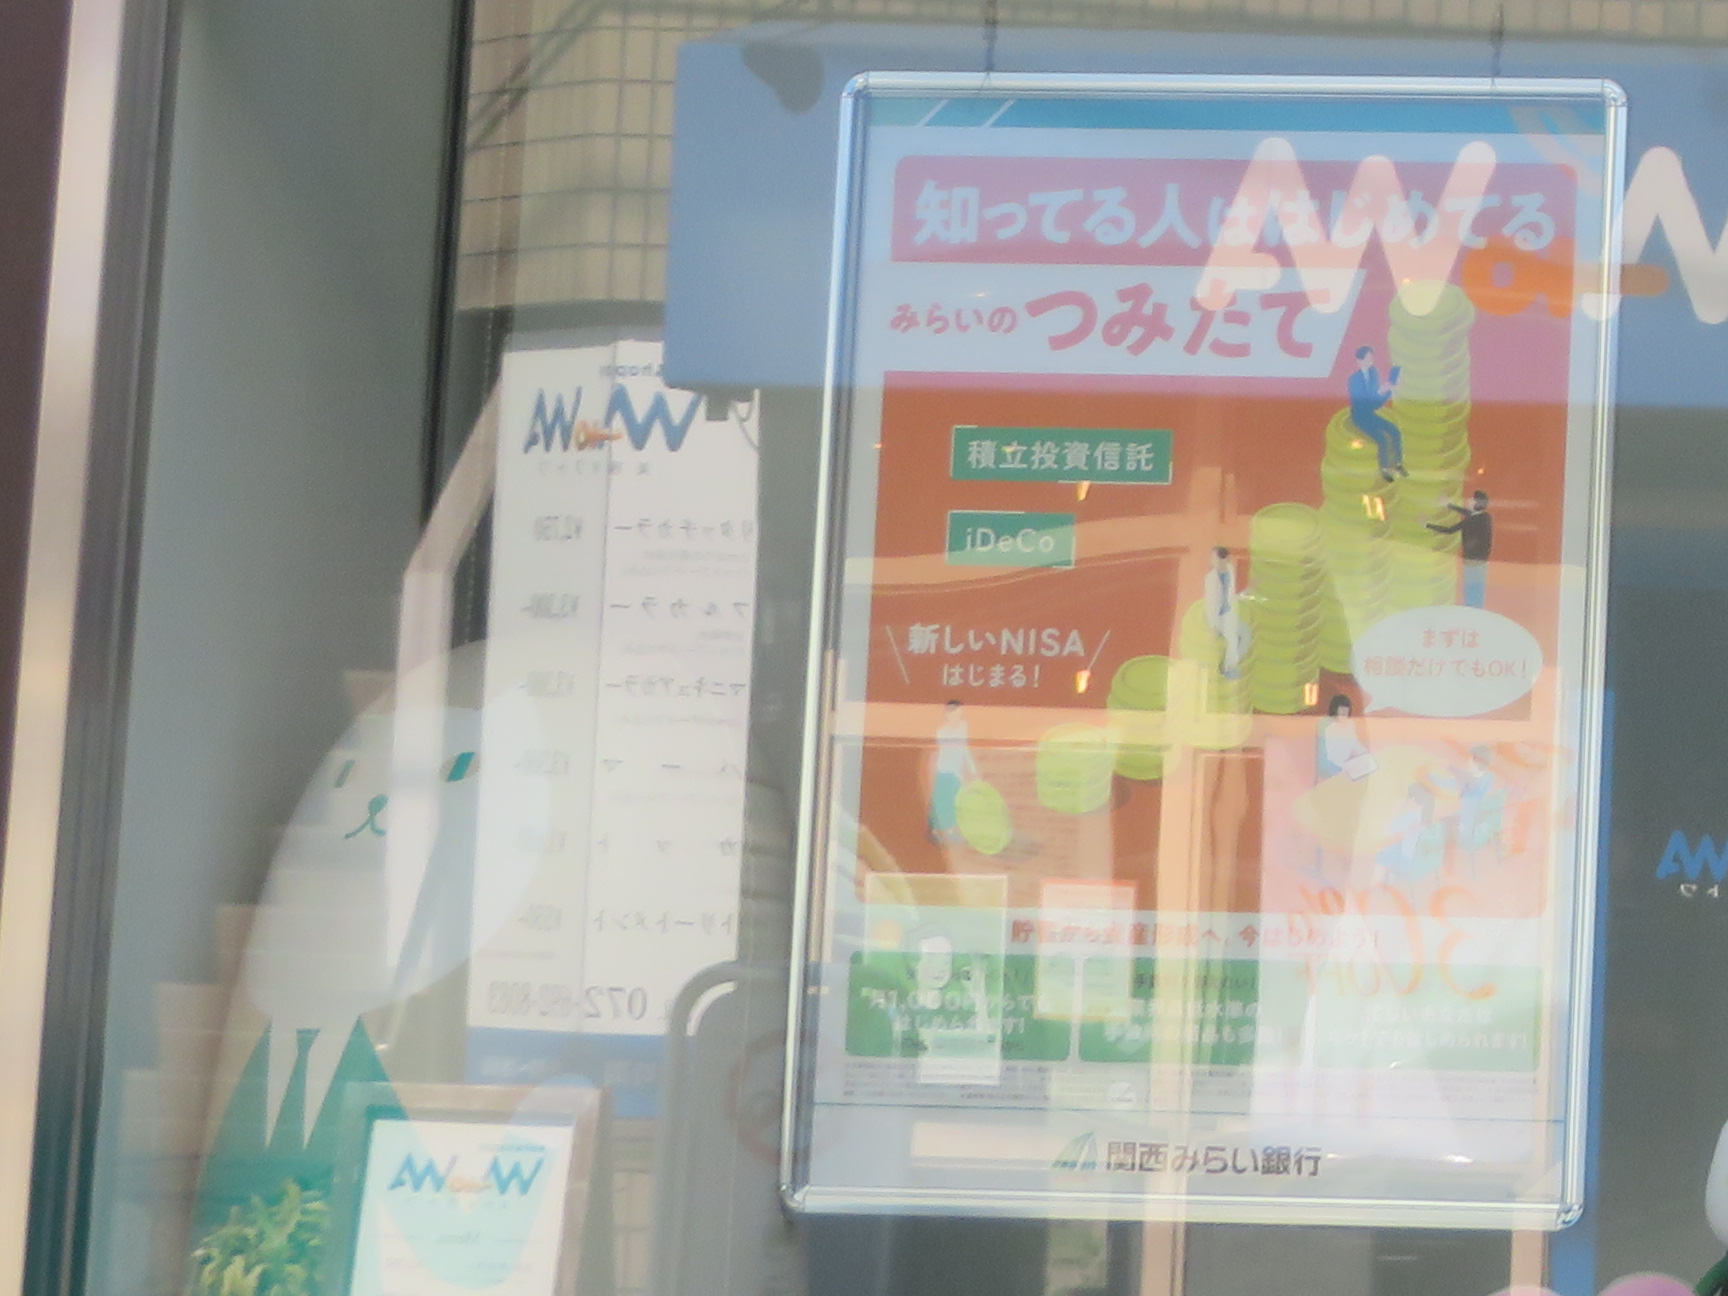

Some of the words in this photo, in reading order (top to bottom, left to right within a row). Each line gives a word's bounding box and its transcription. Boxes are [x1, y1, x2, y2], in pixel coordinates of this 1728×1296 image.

[967, 440, 1153, 472] 積立投資信託
[965, 525, 1055, 555] iDeCo
[908, 623, 1086, 657] 新しいNISA
[1422, 628, 1480, 649] まずは
[1107, 1141, 1321, 1178] 関西みらい銀行
